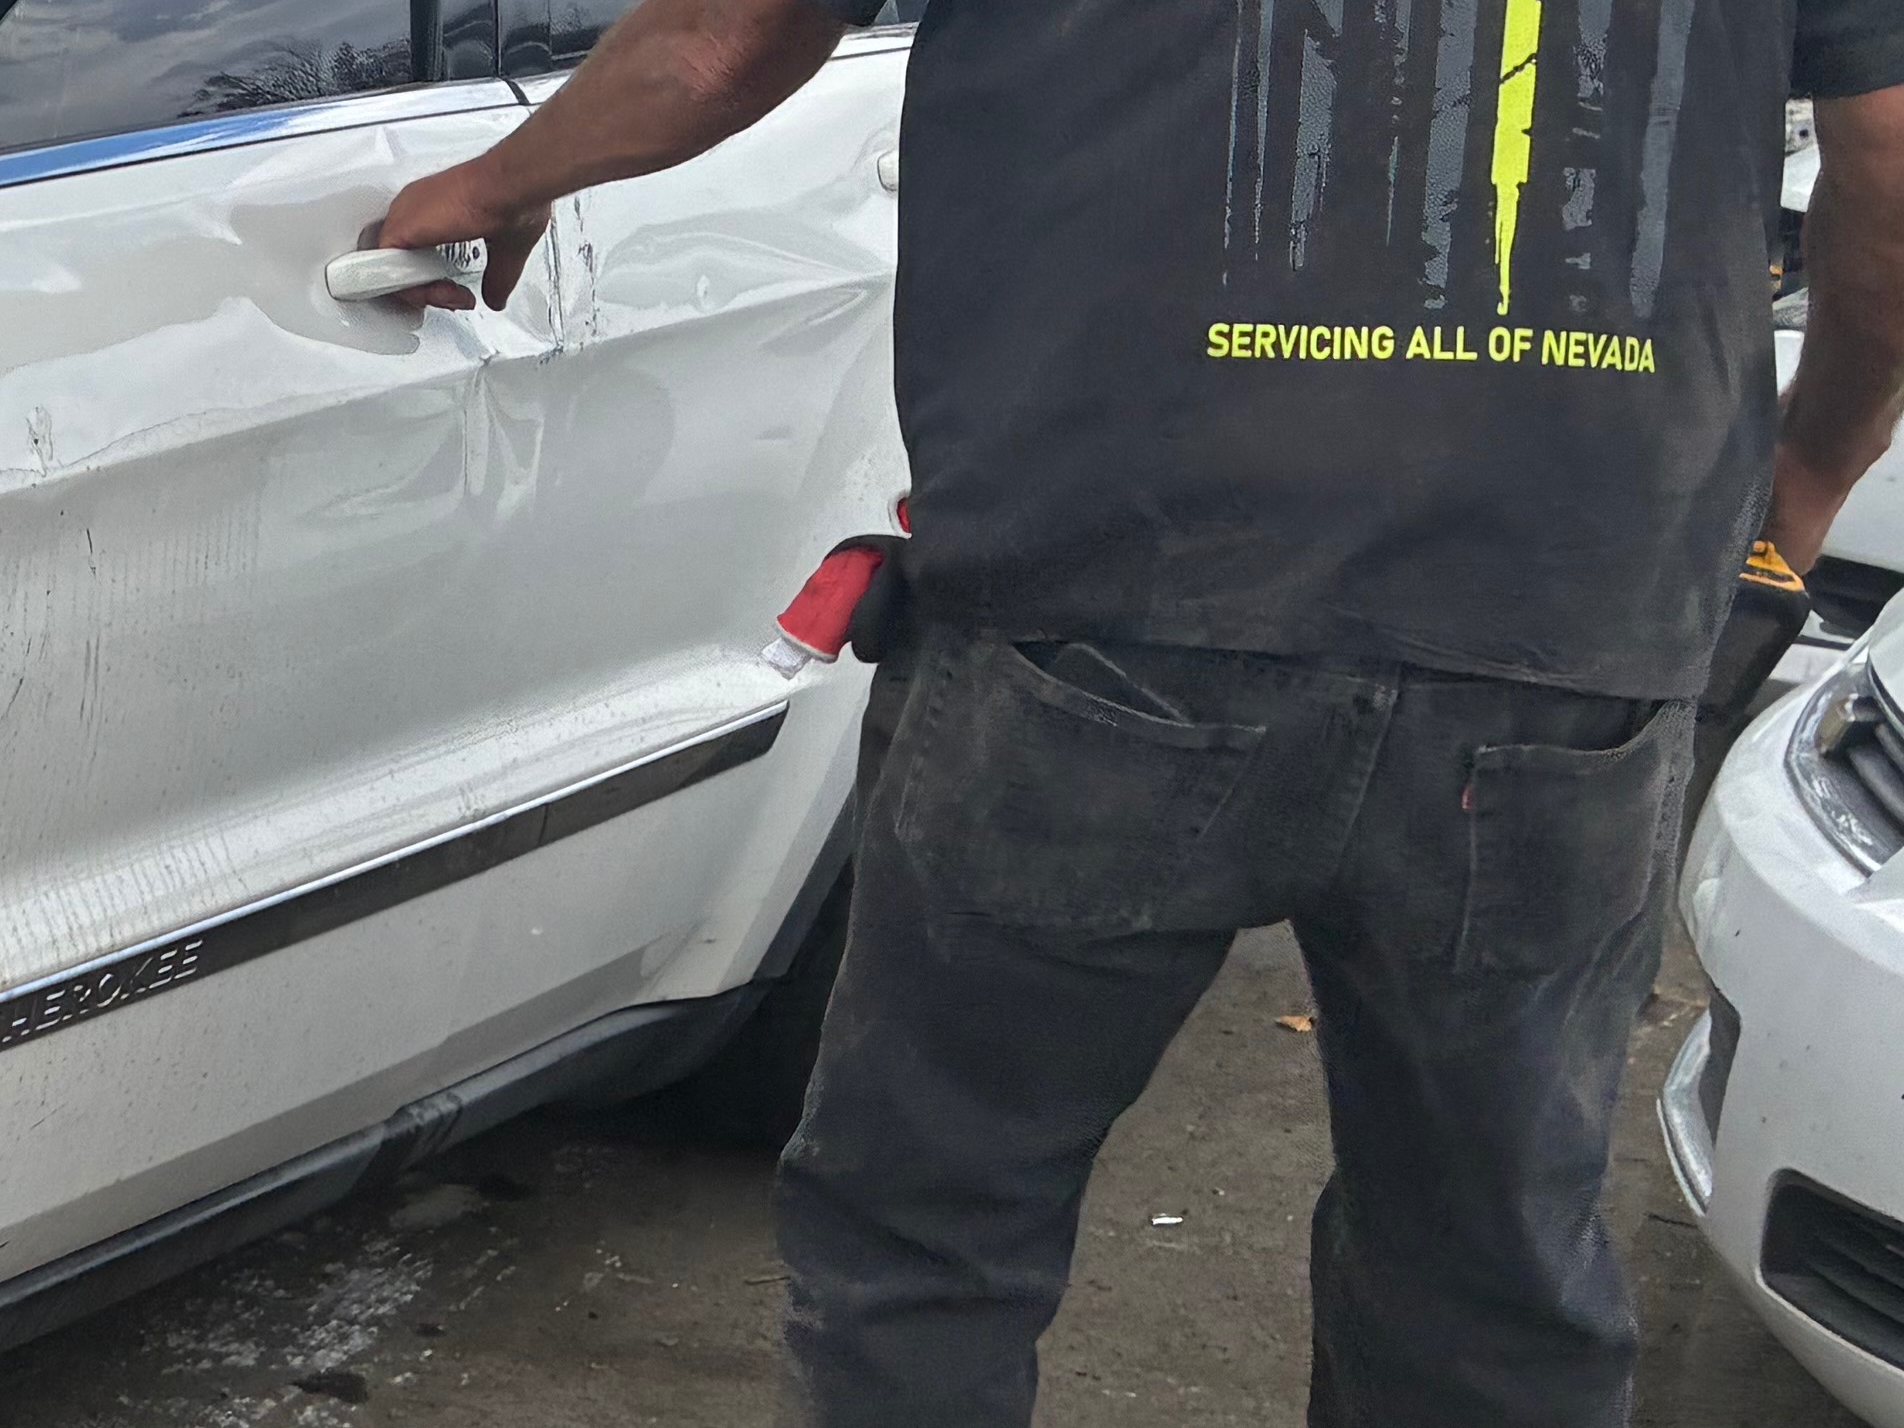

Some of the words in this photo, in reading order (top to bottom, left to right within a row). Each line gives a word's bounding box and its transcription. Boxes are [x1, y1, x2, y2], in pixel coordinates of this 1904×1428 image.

[1207, 322, 1394, 361] SERVICING
[1406, 325, 1477, 361] ALL
[1488, 326, 1533, 362] OF
[1541, 329, 1655, 372] NEVADA
